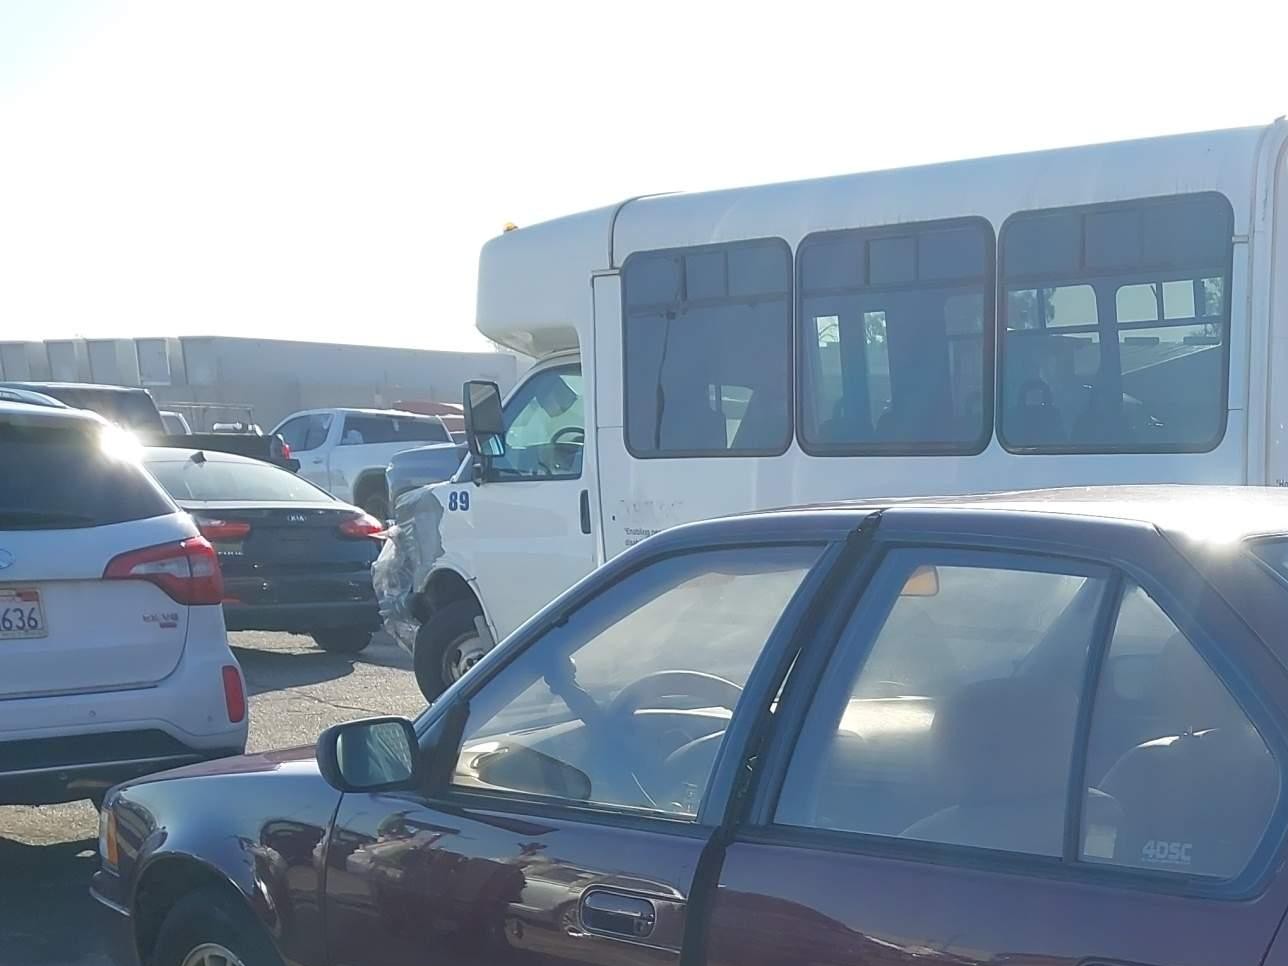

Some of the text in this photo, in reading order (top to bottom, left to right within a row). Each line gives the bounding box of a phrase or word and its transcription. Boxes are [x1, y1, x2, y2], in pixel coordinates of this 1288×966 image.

[449, 491, 470, 511] 89
[0, 607, 39, 631] 636
[1142, 840, 1193, 861] 4DSC
